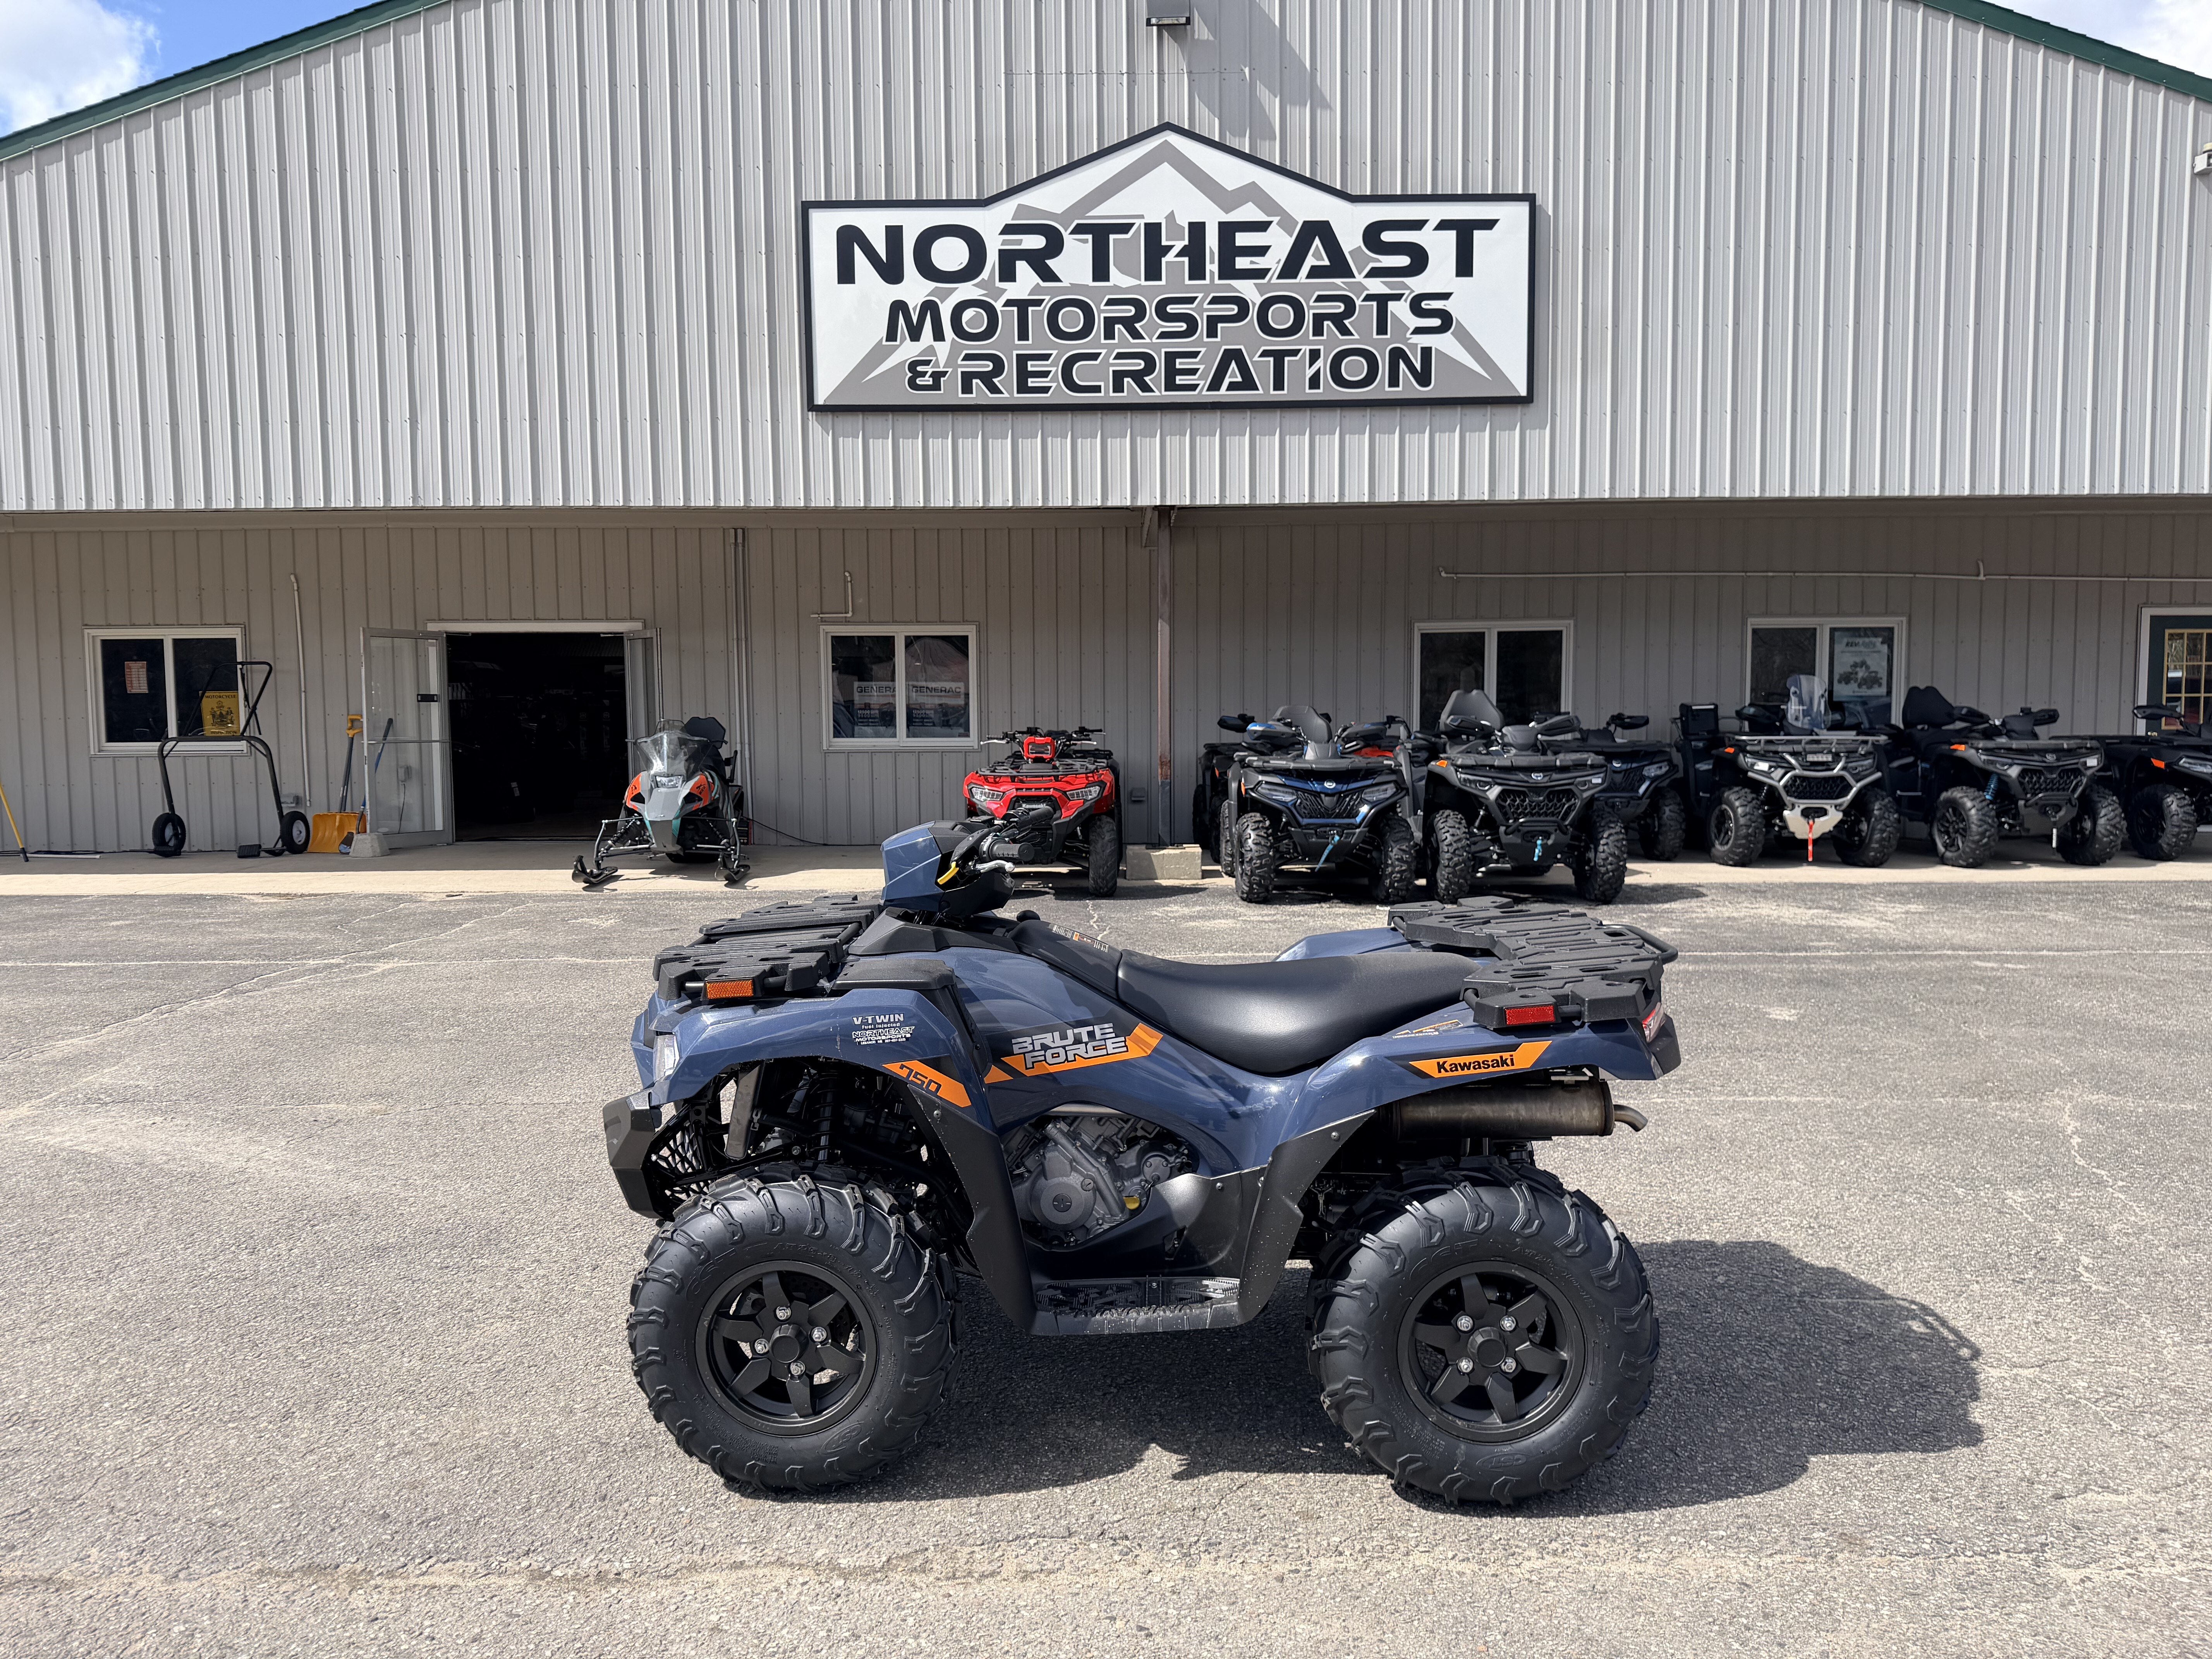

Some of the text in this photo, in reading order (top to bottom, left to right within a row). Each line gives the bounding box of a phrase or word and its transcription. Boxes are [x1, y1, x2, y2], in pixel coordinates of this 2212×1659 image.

[836, 219, 1500, 285] NORTHEAST
[885, 292, 1454, 342] MOTORSPORTS
[907, 347, 1432, 394] & RECREATION
[912, 686, 961, 694] GENERAC
[852, 1026, 915, 1038] NORTHEAST
[853, 1013, 904, 1024] V-TWIN
[855, 1033, 911, 1042] MOTORSPORTS
[1012, 1023, 1115, 1054] BRUTE
[1025, 1037, 1127, 1068] FORCE
[1436, 1054, 1515, 1073] Kawasaki
[899, 1063, 942, 1096] 750
